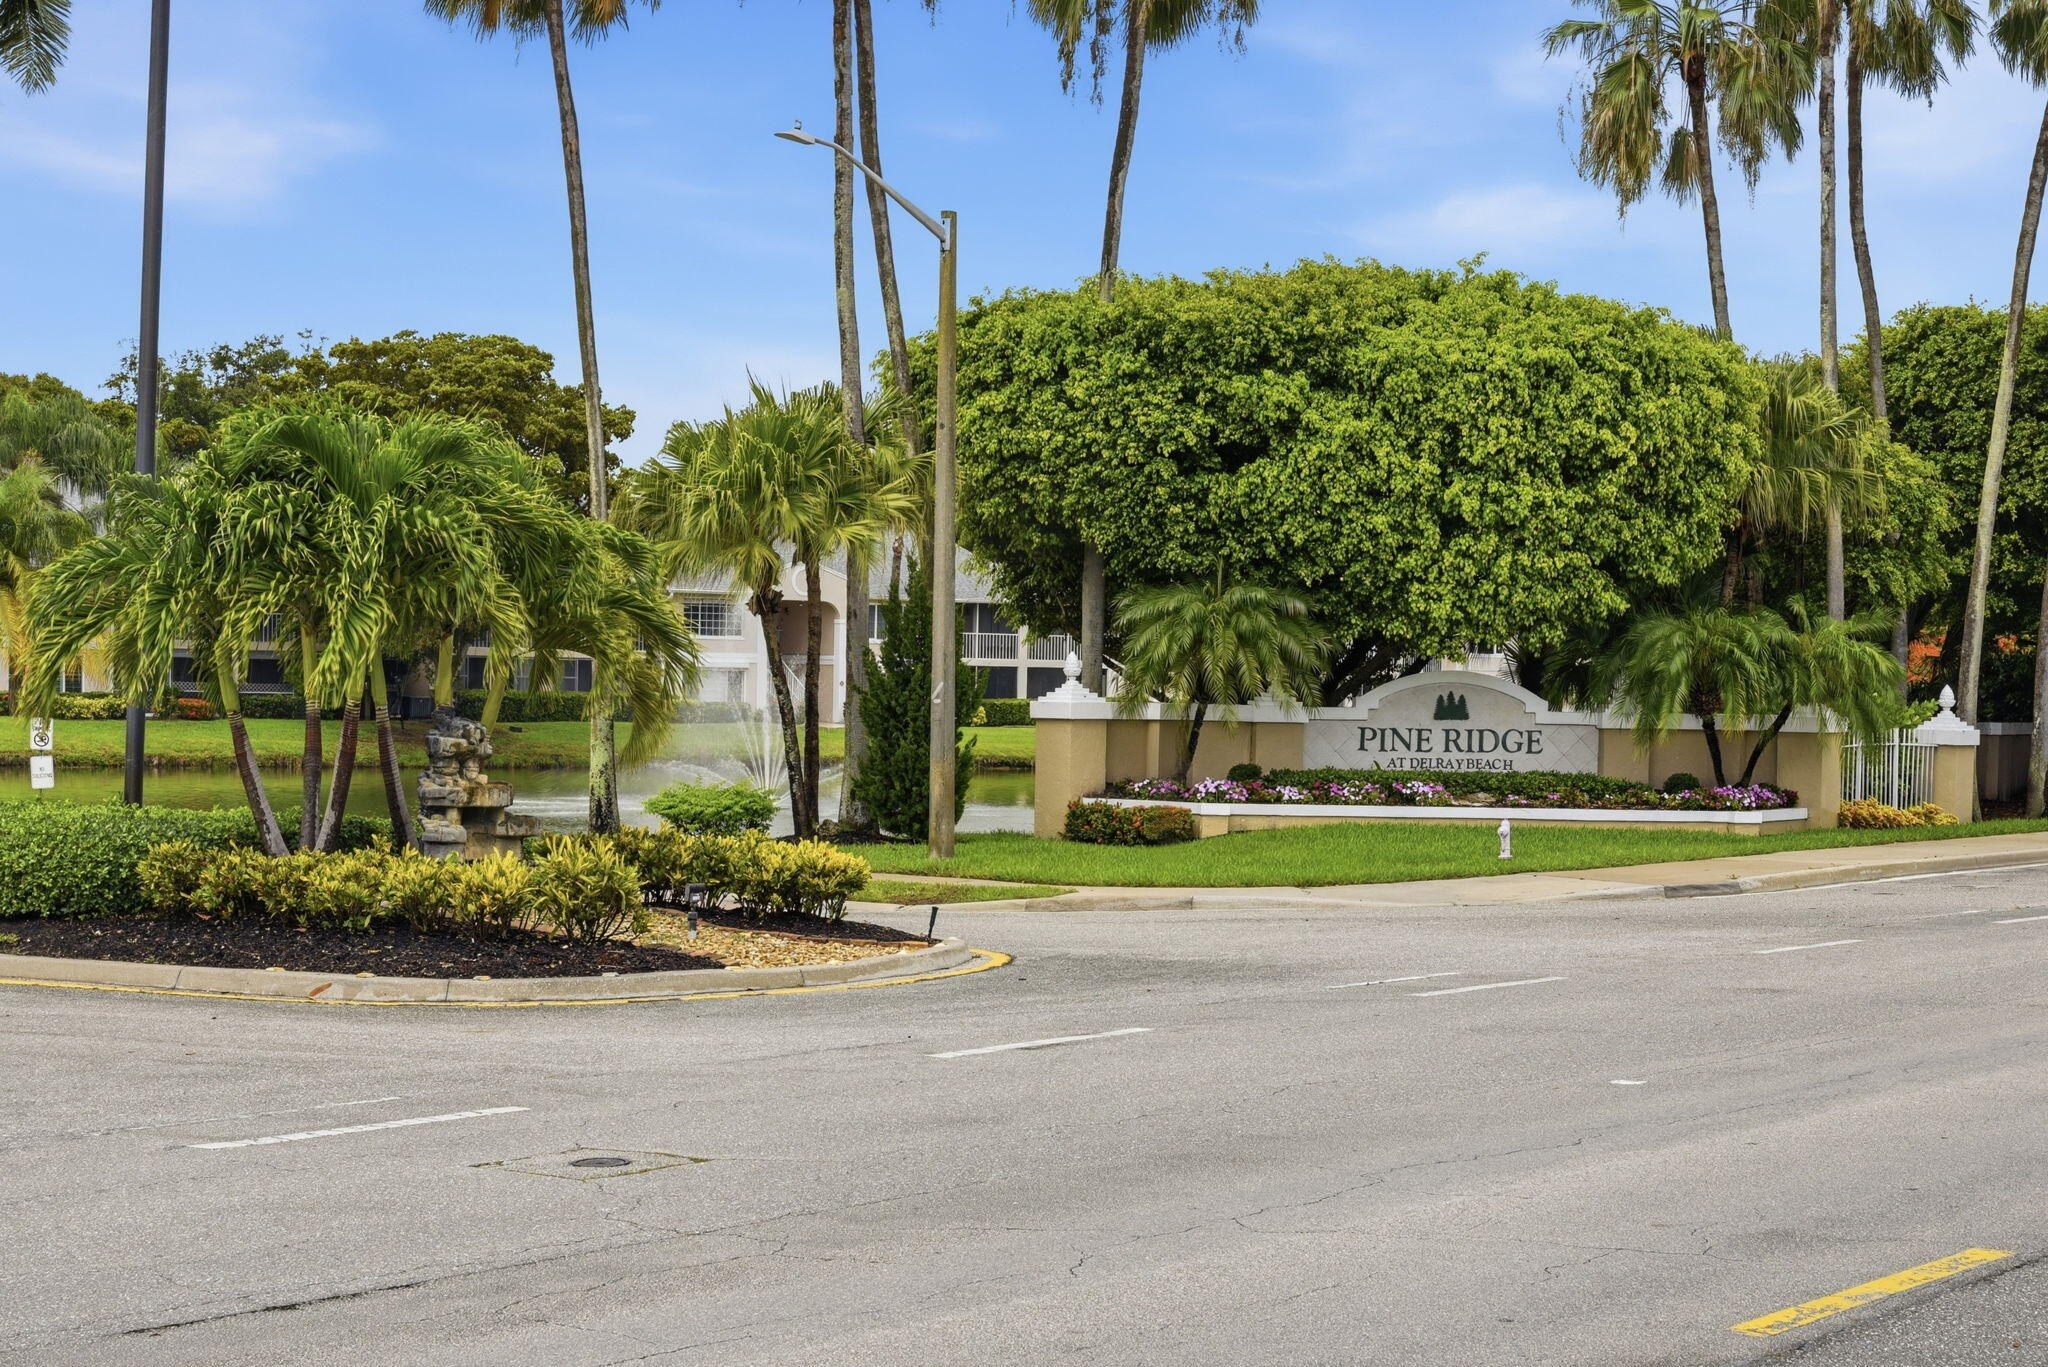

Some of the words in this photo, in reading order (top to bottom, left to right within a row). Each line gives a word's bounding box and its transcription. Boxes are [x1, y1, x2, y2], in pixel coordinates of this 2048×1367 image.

[1357, 726, 1433, 752] PINE
[1441, 728, 1544, 755] RIDGE
[1386, 757, 1406, 769] AT
